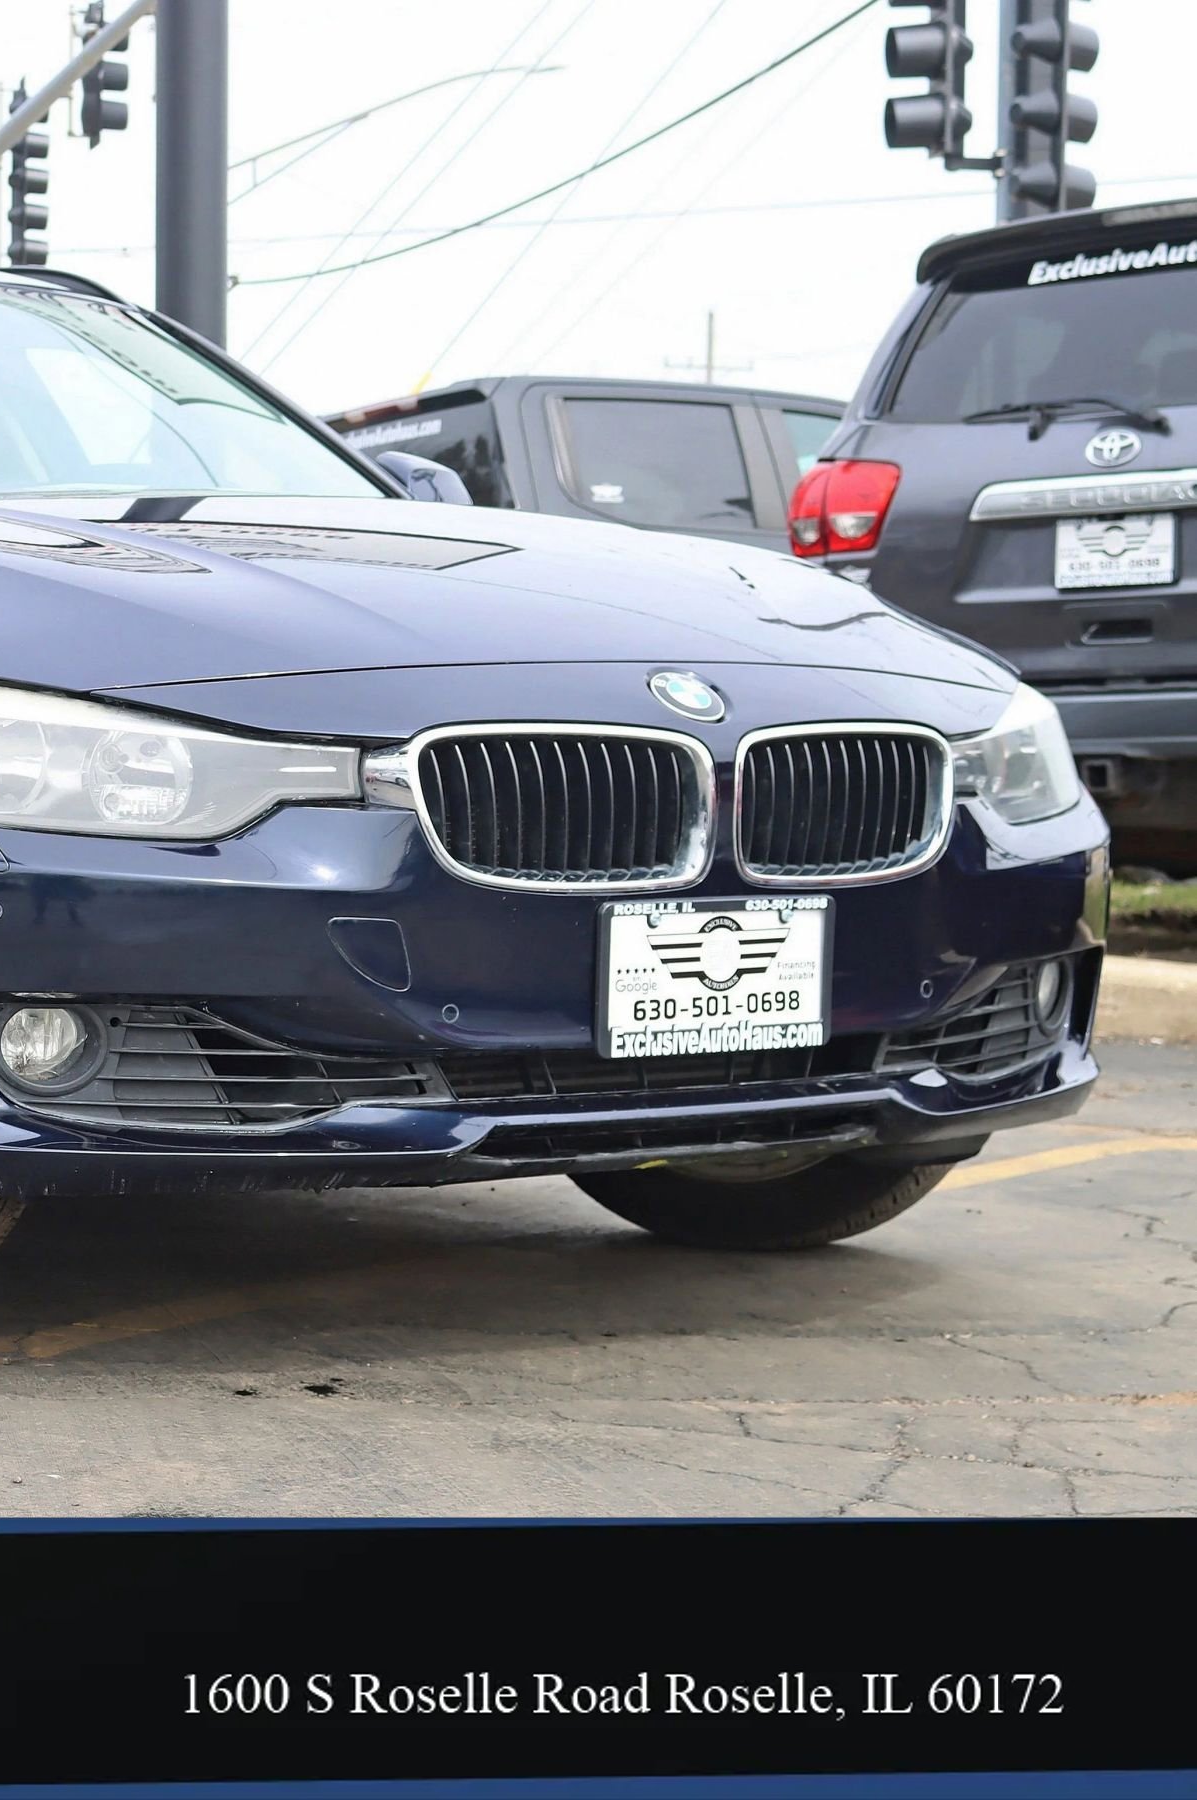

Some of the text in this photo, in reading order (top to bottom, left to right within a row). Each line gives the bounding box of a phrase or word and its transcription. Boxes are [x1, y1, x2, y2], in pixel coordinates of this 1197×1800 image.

[614, 901, 696, 915] ROSELLE, IL
[745, 897, 828, 911] 630-501-0698
[615, 977, 658, 995] Google
[633, 989, 800, 1021] 630-501-0698
[611, 1020, 823, 1058] ExclusiveAutoHaus.com
